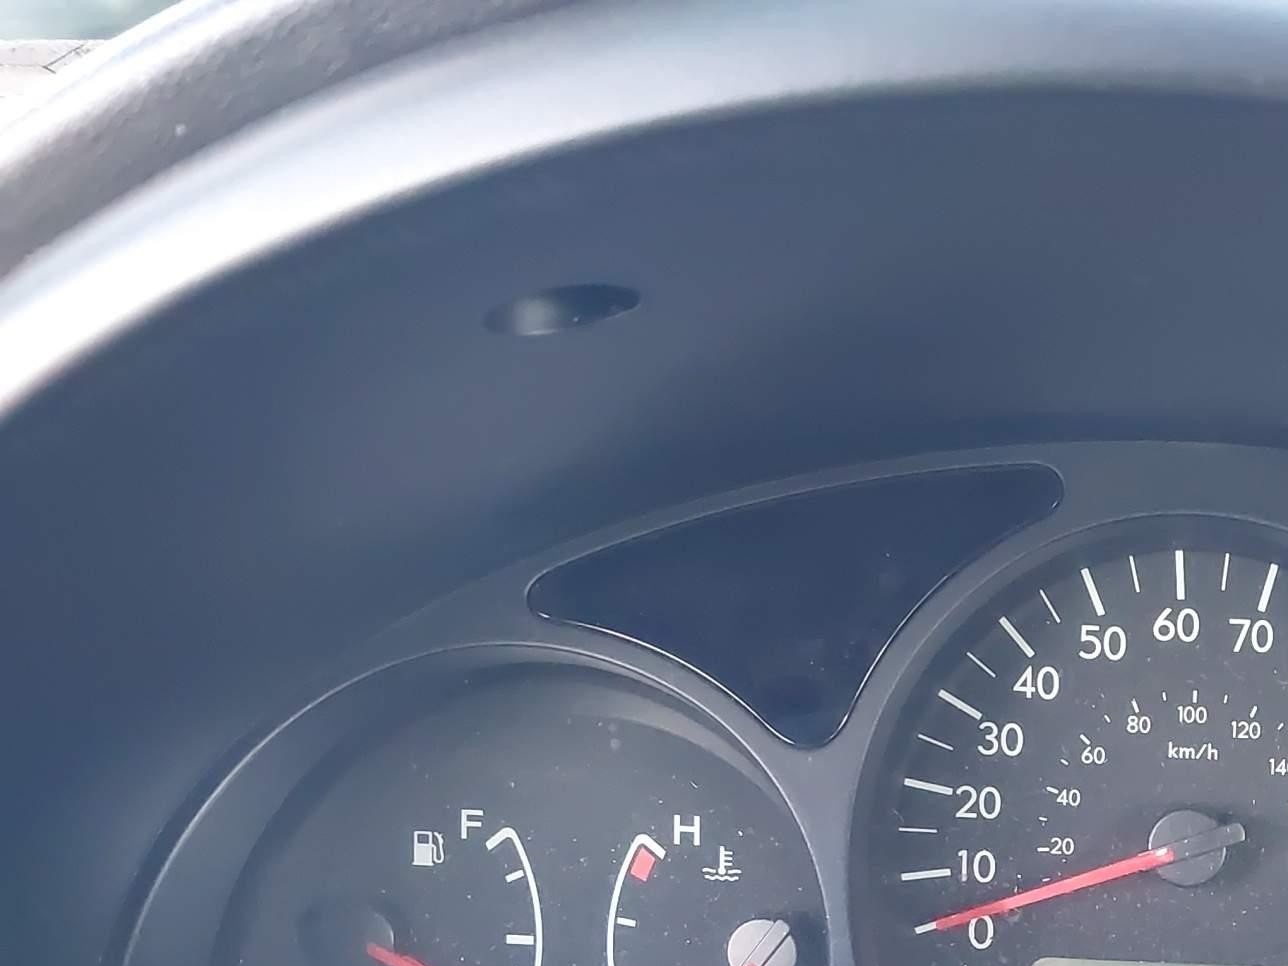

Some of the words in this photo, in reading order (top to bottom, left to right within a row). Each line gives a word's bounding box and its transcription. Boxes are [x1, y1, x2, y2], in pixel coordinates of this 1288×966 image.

[1152, 608, 1200, 642] 60
[1229, 619, 1273, 654] 70
[1078, 625, 1127, 660] 50
[1013, 666, 1059, 700] 40
[1127, 715, 1151, 734] 80
[1177, 706, 1207, 725] 100
[1232, 721, 1261, 740] 120
[978, 723, 1024, 756] 30
[1167, 742, 1218, 761] km/h
[1081, 746, 1106, 765] 60
[955, 786, 1001, 819] 20
[1056, 788, 1081, 807] 40
[461, 809, 483, 839] F
[674, 815, 701, 846] H
[1050, 837, 1074, 856] 20
[957, 850, 995, 883] 10
[968, 916, 994, 950] 0
